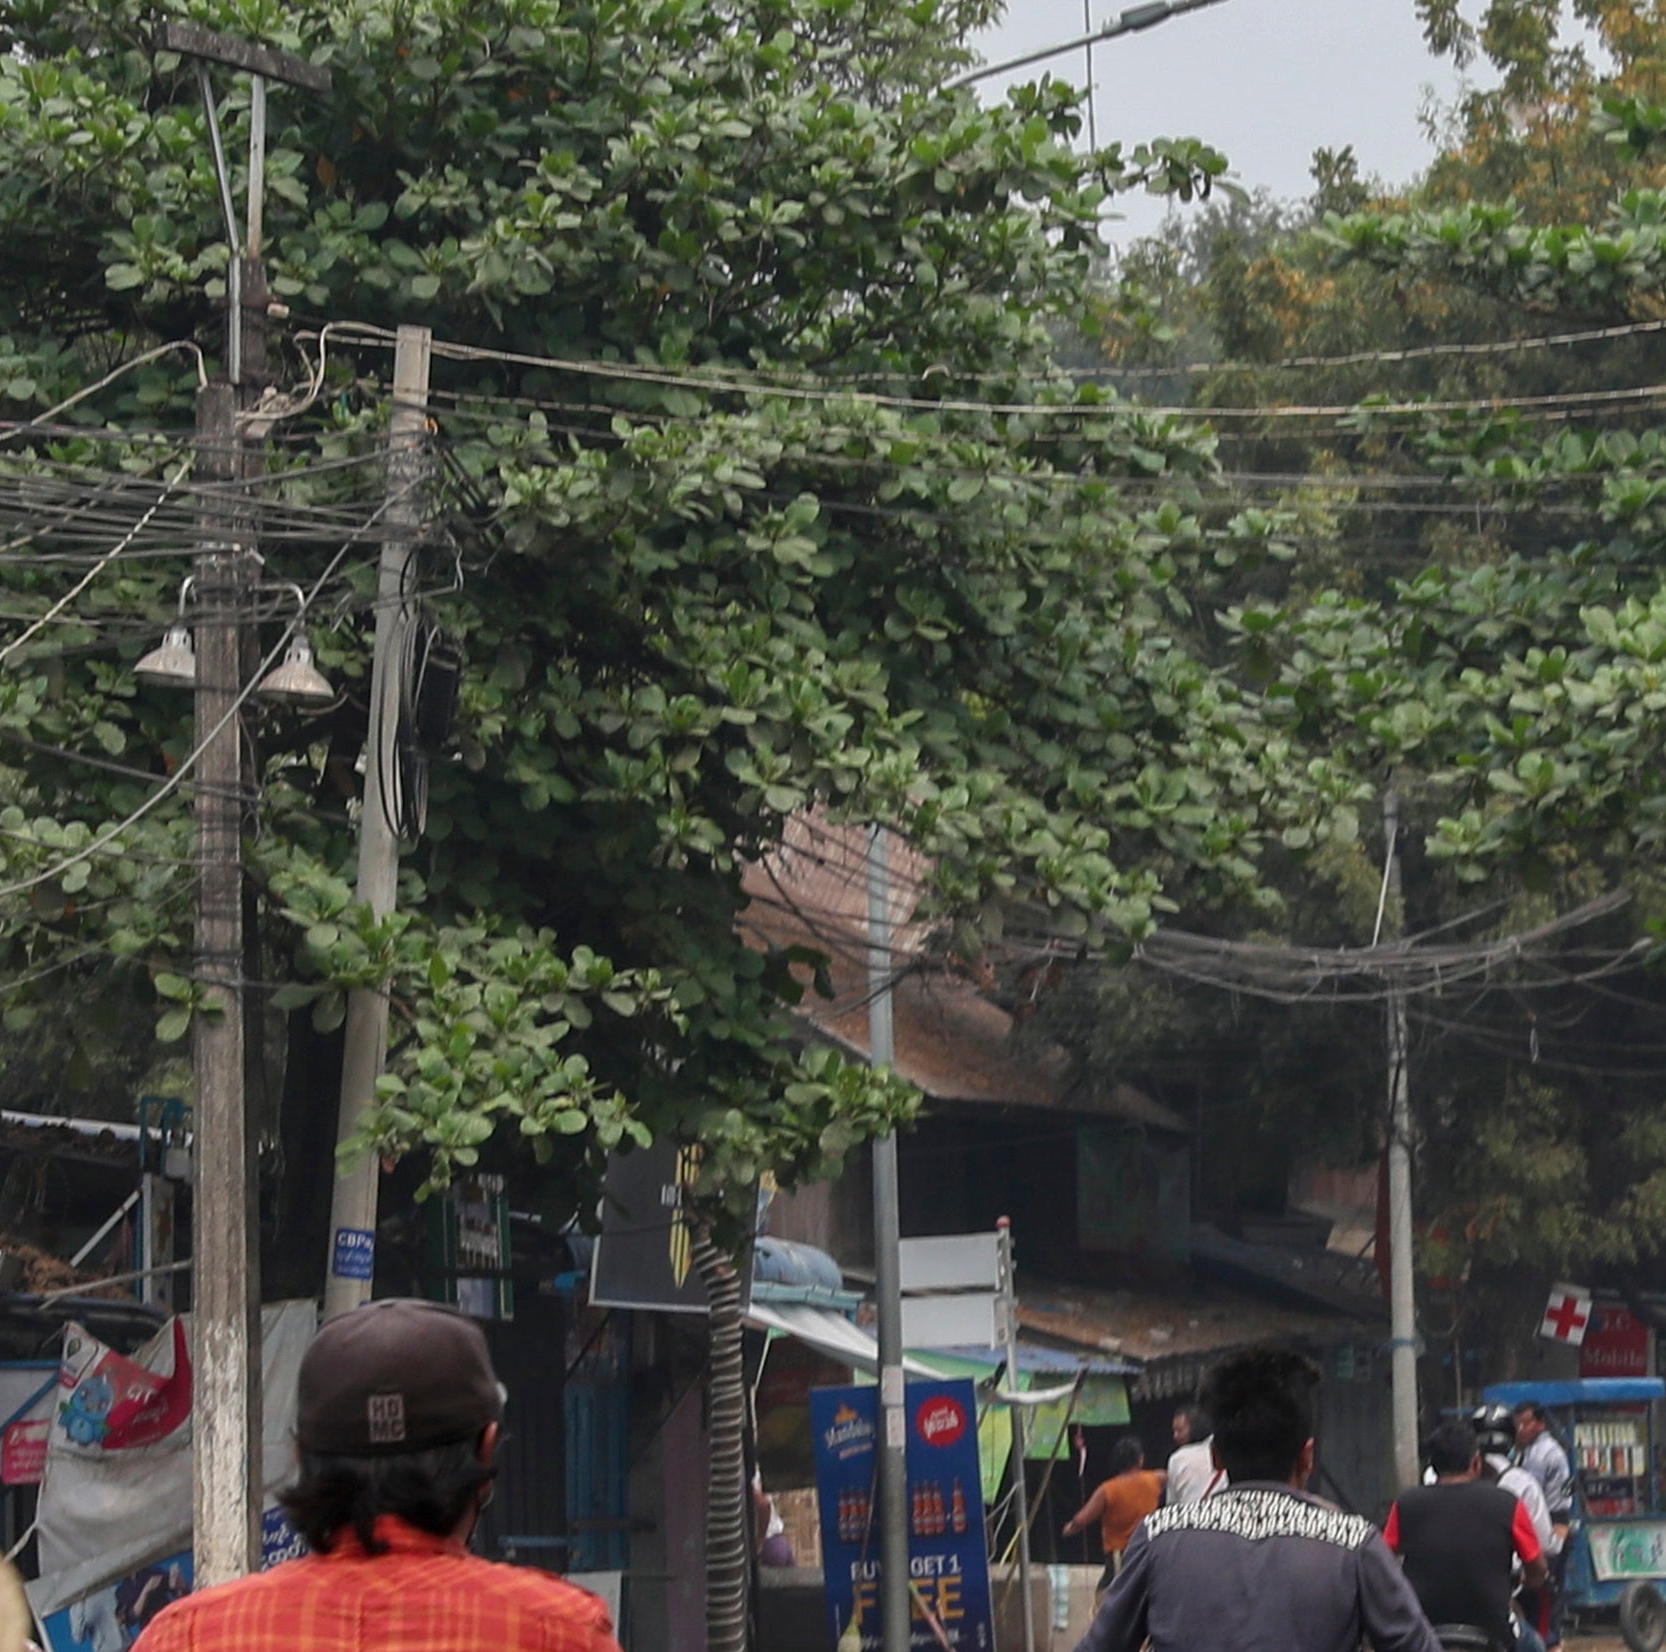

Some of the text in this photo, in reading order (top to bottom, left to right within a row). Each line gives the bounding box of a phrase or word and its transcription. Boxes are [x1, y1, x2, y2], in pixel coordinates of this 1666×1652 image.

[910, 1555, 946, 1576] GET
[950, 1553, 963, 1575] 1
[853, 1577, 964, 1625] FEE
